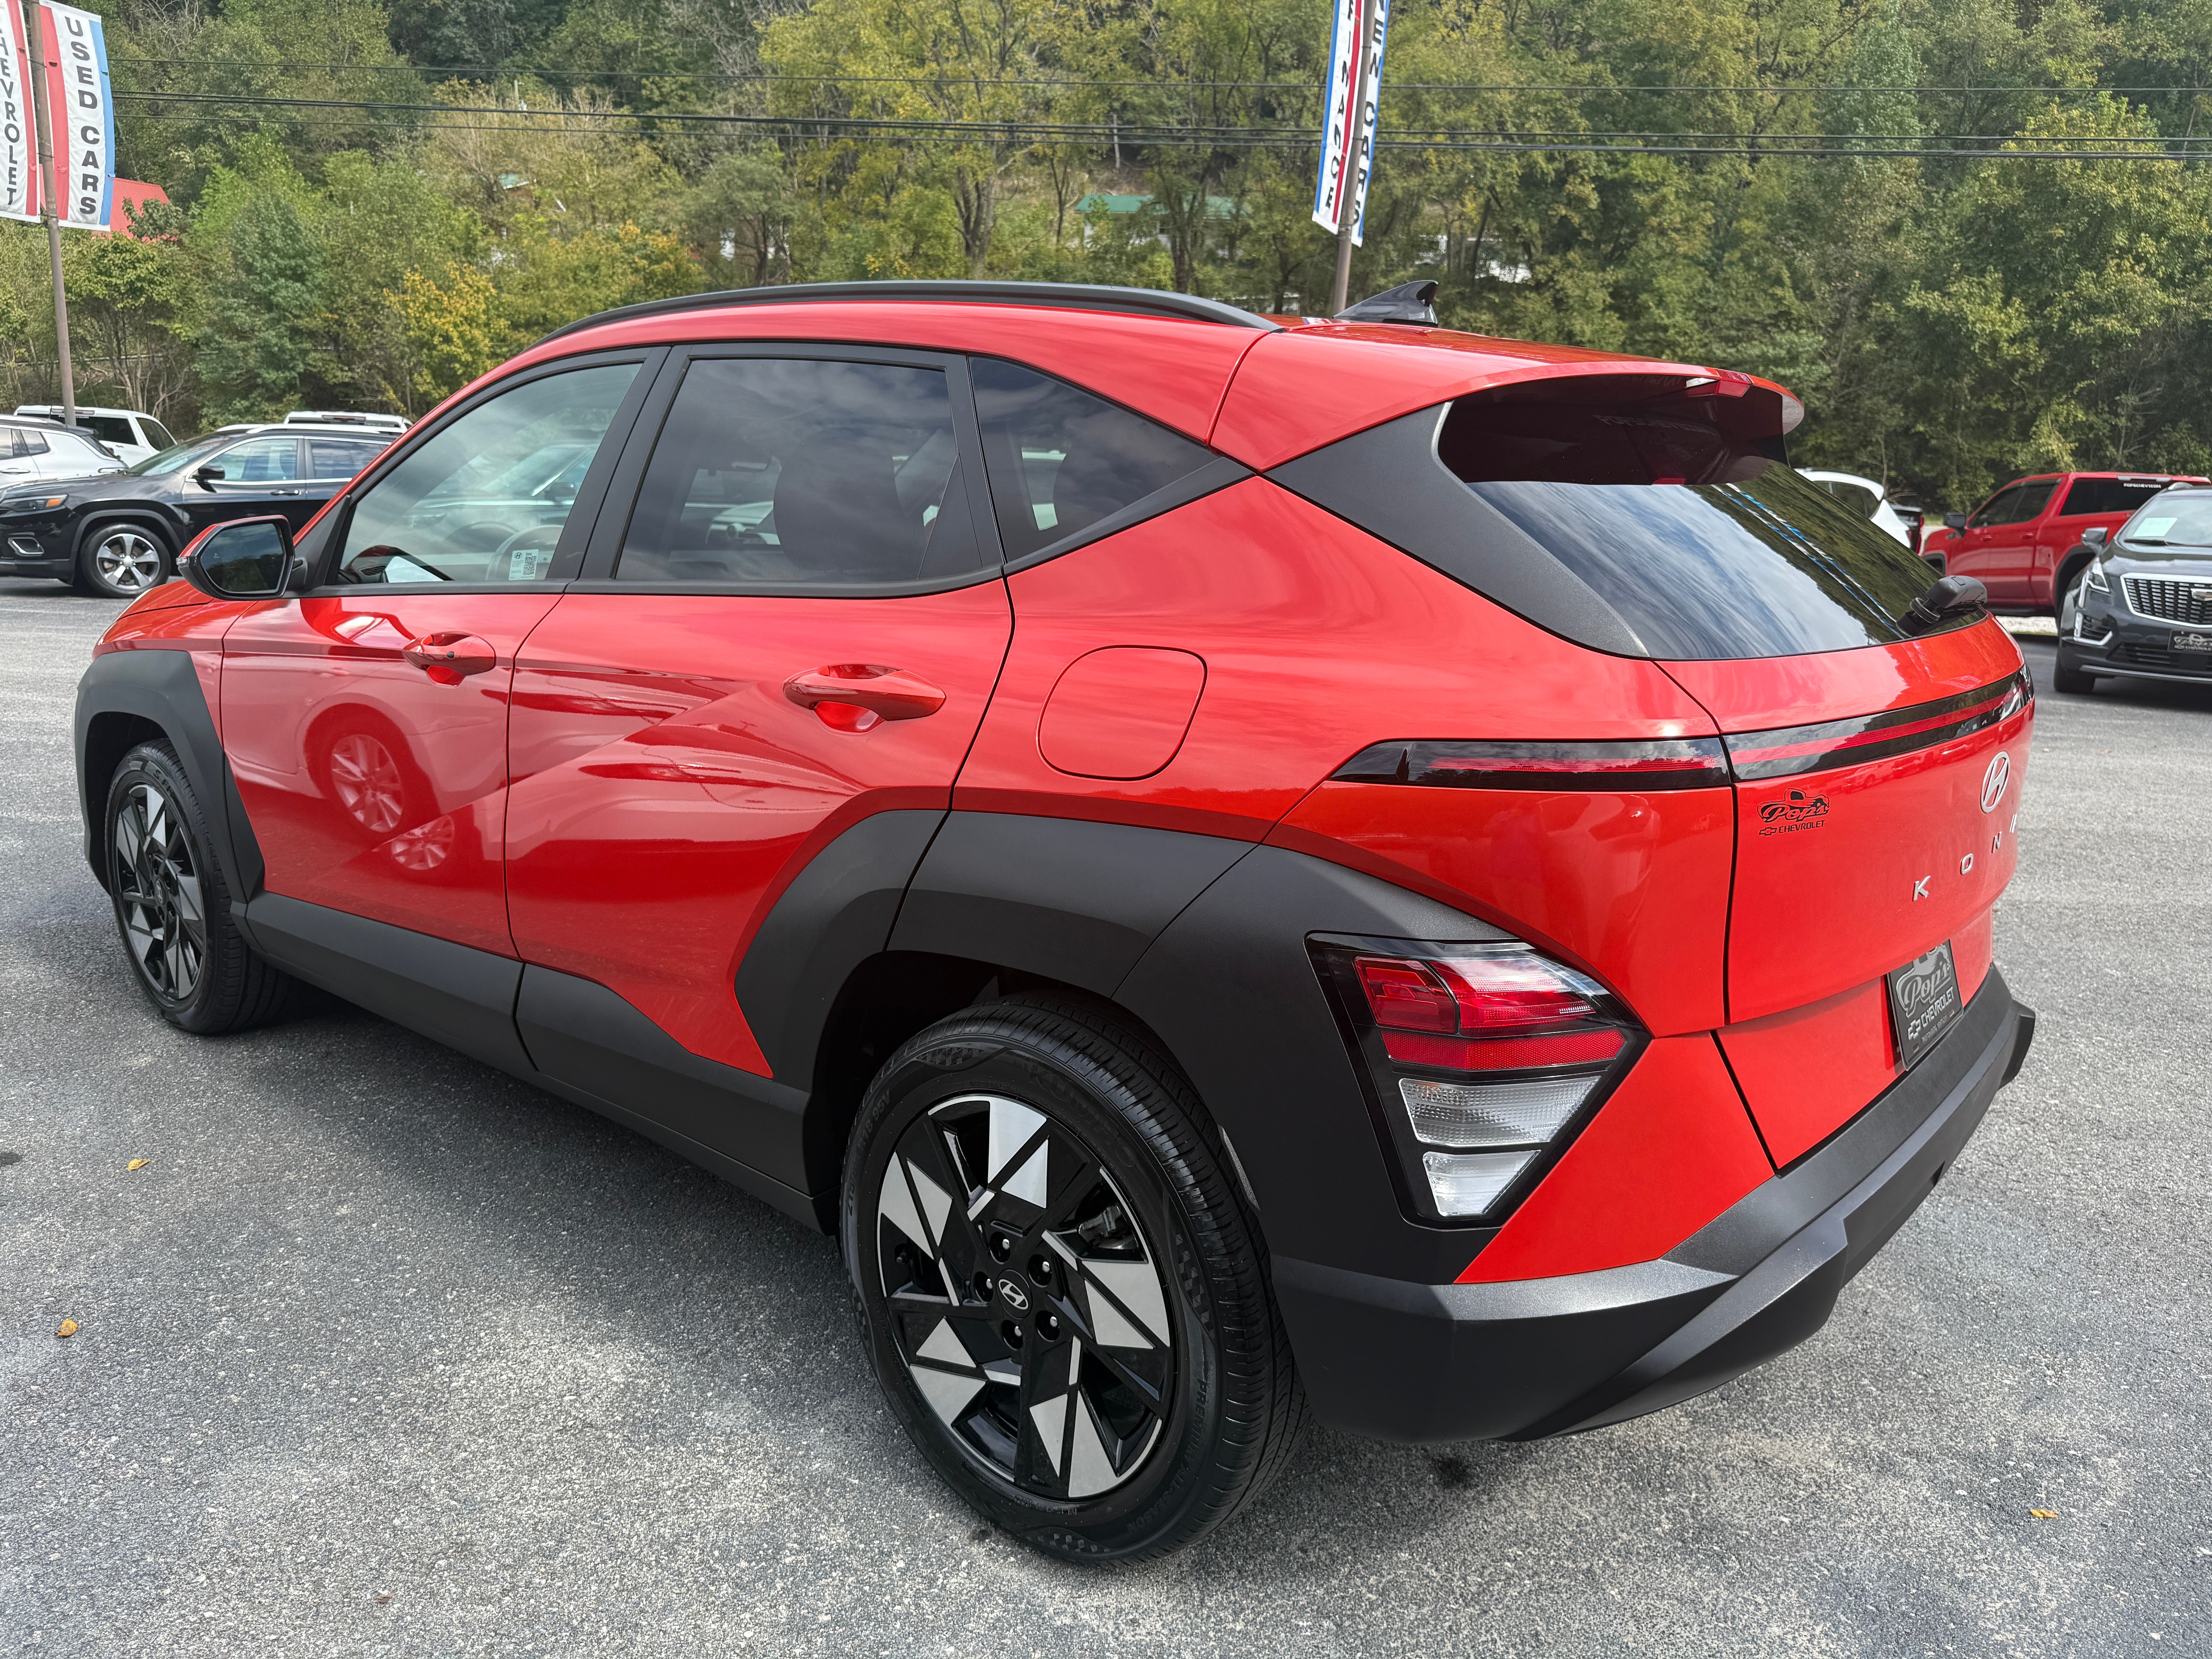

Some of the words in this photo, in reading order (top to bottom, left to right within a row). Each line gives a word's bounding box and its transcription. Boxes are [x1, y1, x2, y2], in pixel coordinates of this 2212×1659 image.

[65, 16, 98, 110] USED
[0, 27, 20, 205] HEVROLET
[79, 125, 100, 215] CARS
[1779, 820, 1826, 833] CHEVROLET
[1904, 961, 1951, 1010] Pop's
[1921, 986, 1954, 1029] CHEVROLET
[871, 1087, 895, 1123] 95V
